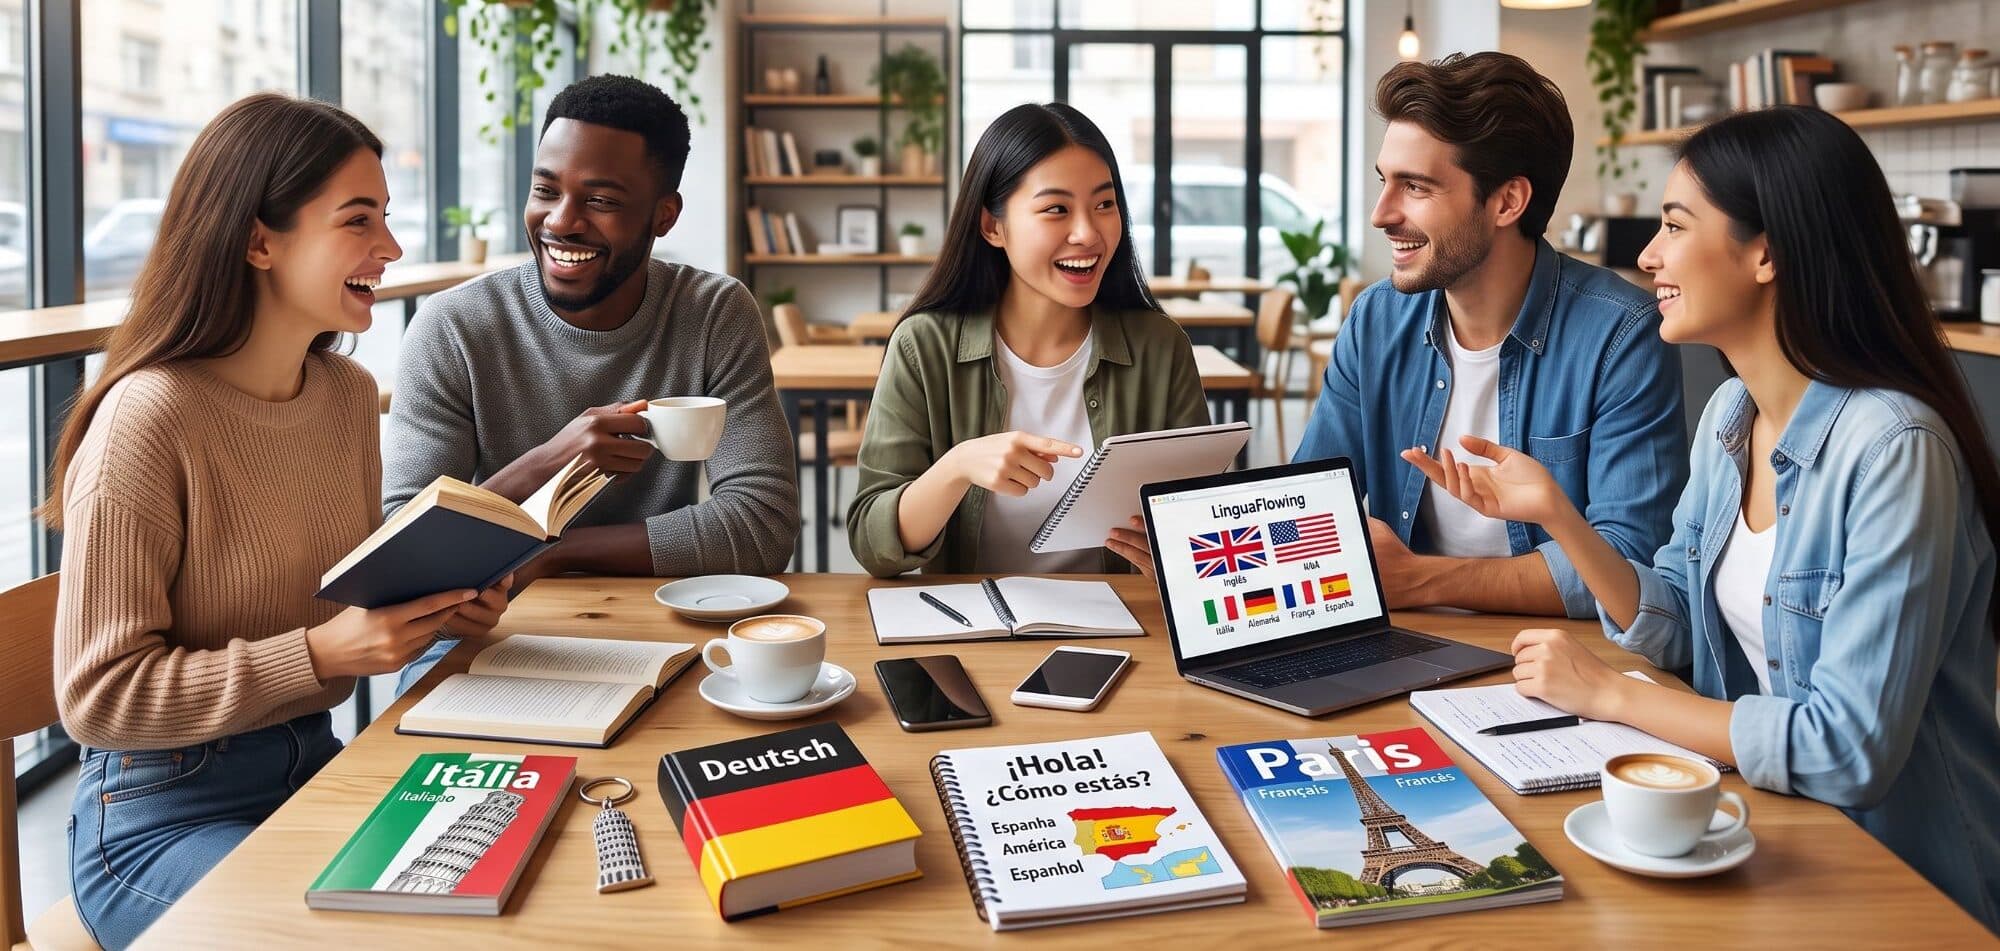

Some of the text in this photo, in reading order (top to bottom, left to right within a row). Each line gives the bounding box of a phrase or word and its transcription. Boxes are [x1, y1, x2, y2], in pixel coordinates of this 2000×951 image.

[1211, 494, 1306, 519] LinguaFlowing
[1325, 600, 1354, 613] Espanha
[699, 738, 838, 781] Deutsch
[1006, 748, 1108, 781] ¡Hola!
[422, 762, 540, 789] Itália
[399, 791, 455, 803] Italiano
[986, 770, 1151, 807] ¿Cómo estás?
[1257, 786, 1329, 800] Français
[991, 817, 1056, 836] Espanha
[1002, 837, 1066, 855] América
[1010, 860, 1084, 883] Espanhol
